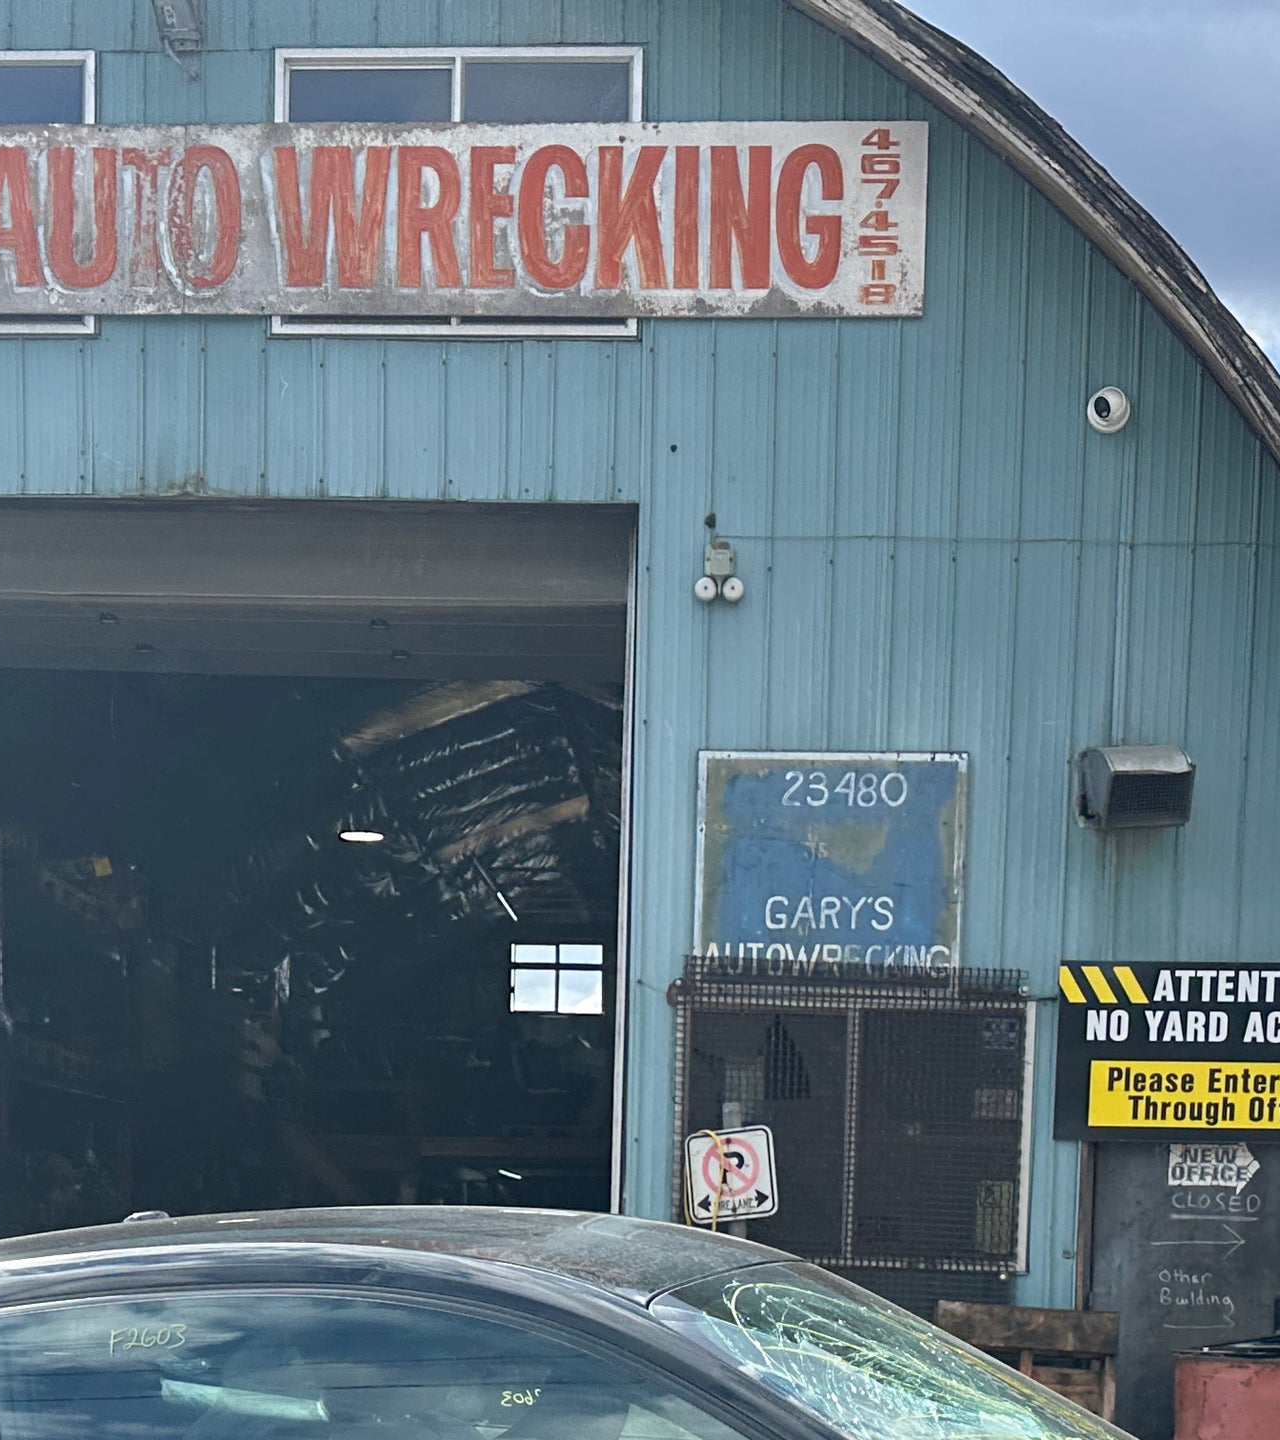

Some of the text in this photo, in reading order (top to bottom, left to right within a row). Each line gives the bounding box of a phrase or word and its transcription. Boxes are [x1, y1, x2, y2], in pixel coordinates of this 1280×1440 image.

[266, 143, 845, 291] WRECKING
[781, 770, 908, 807] 23480
[765, 896, 894, 929] GARY'S
[1086, 1009, 1129, 1042] NO
[1146, 1010, 1229, 1043] YARD
[1107, 1067, 1194, 1093] Please
[1209, 1068, 1280, 1094] Enter
[1128, 1095, 1235, 1126] Through
[1184, 1148, 1237, 1163] NEW
[1171, 1163, 1249, 1182] OFFICE
[1172, 1191, 1261, 1213] CLOSED
[1158, 1269, 1213, 1284] Other
